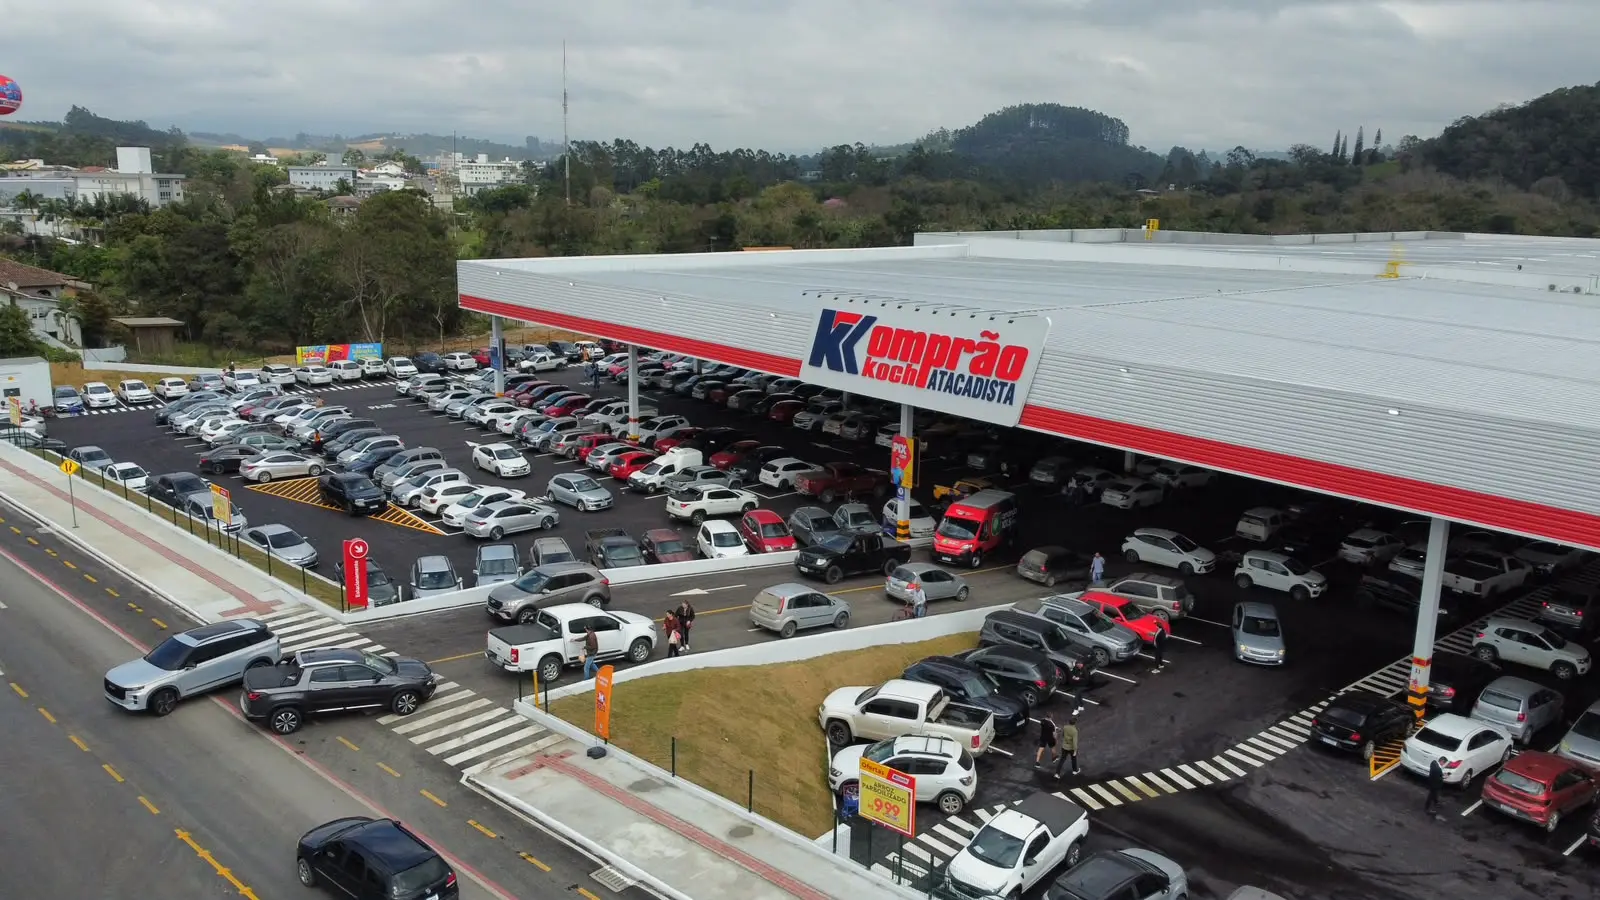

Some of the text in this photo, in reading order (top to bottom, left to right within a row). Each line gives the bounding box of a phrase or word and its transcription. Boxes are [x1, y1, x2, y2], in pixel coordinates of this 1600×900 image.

[926, 369, 1016, 406] ATACADISTA
[892, 442, 907, 454] PIX
[353, 560, 361, 598] Estacionamento
[861, 762, 885, 775] Ofertas
[862, 782, 907, 804] PARBOILIZADO
[873, 781, 895, 793] ARROZ
